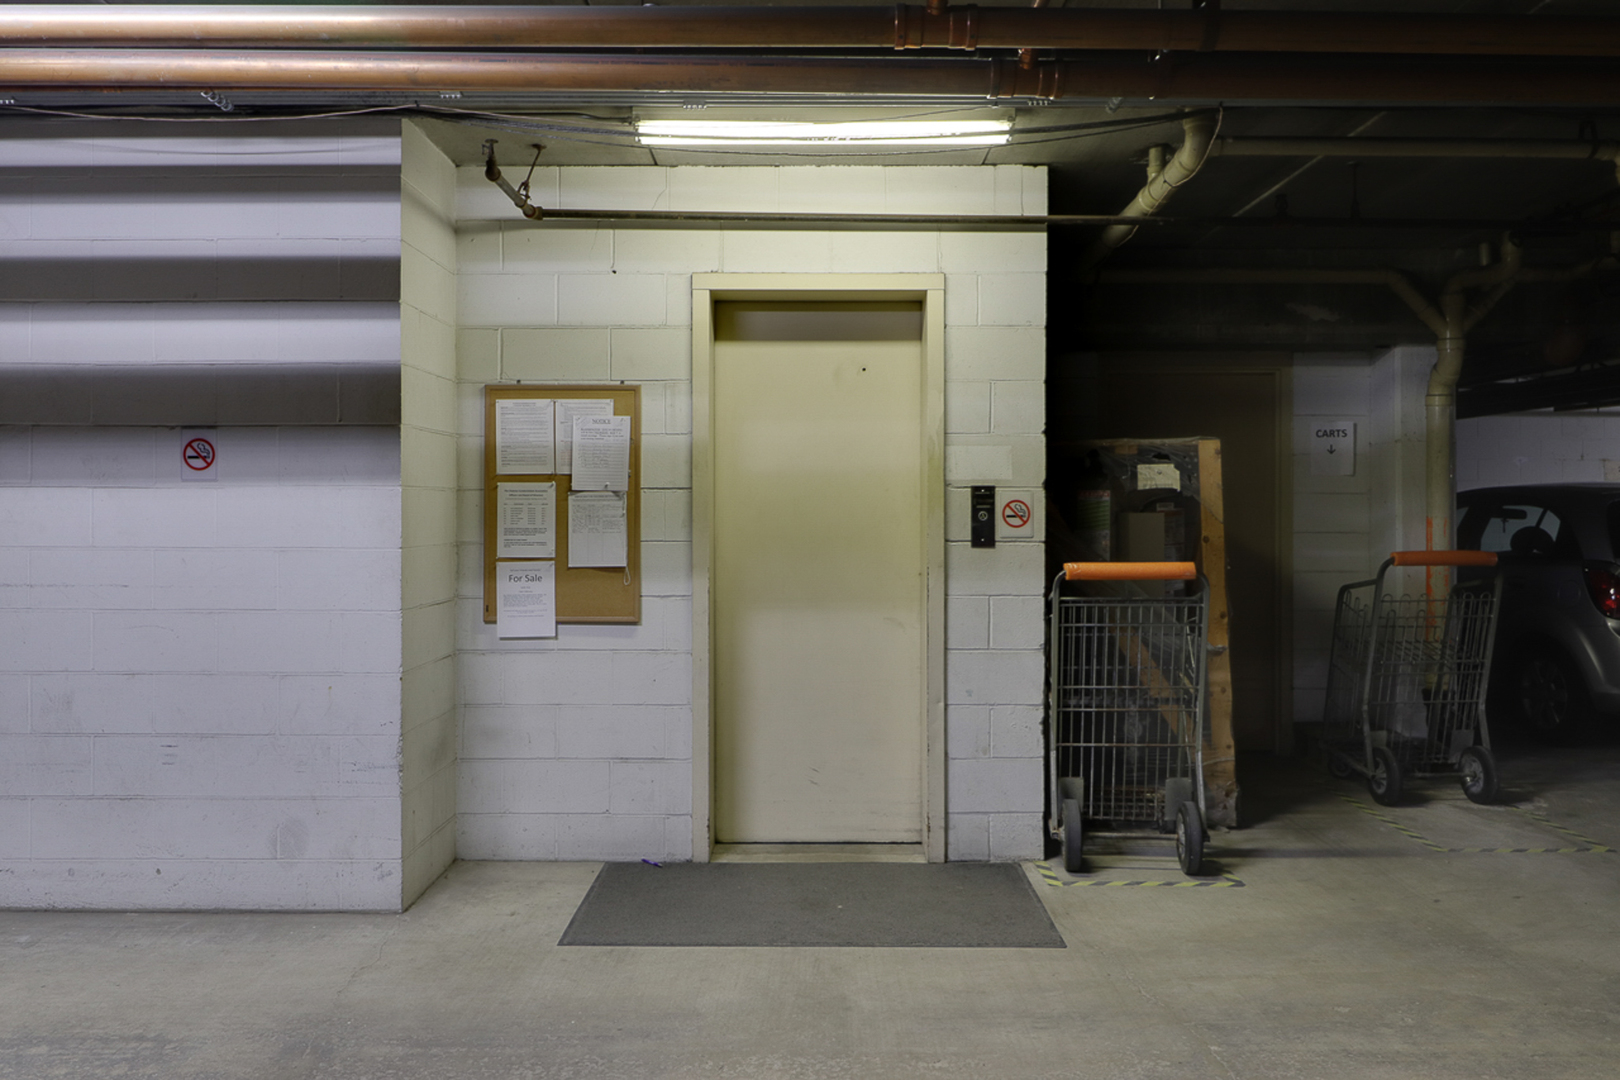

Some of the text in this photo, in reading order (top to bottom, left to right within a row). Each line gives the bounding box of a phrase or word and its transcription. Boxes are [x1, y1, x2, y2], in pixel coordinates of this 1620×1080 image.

[1315, 429, 1348, 438] CARTS
[508, 574, 543, 583] For Sale
